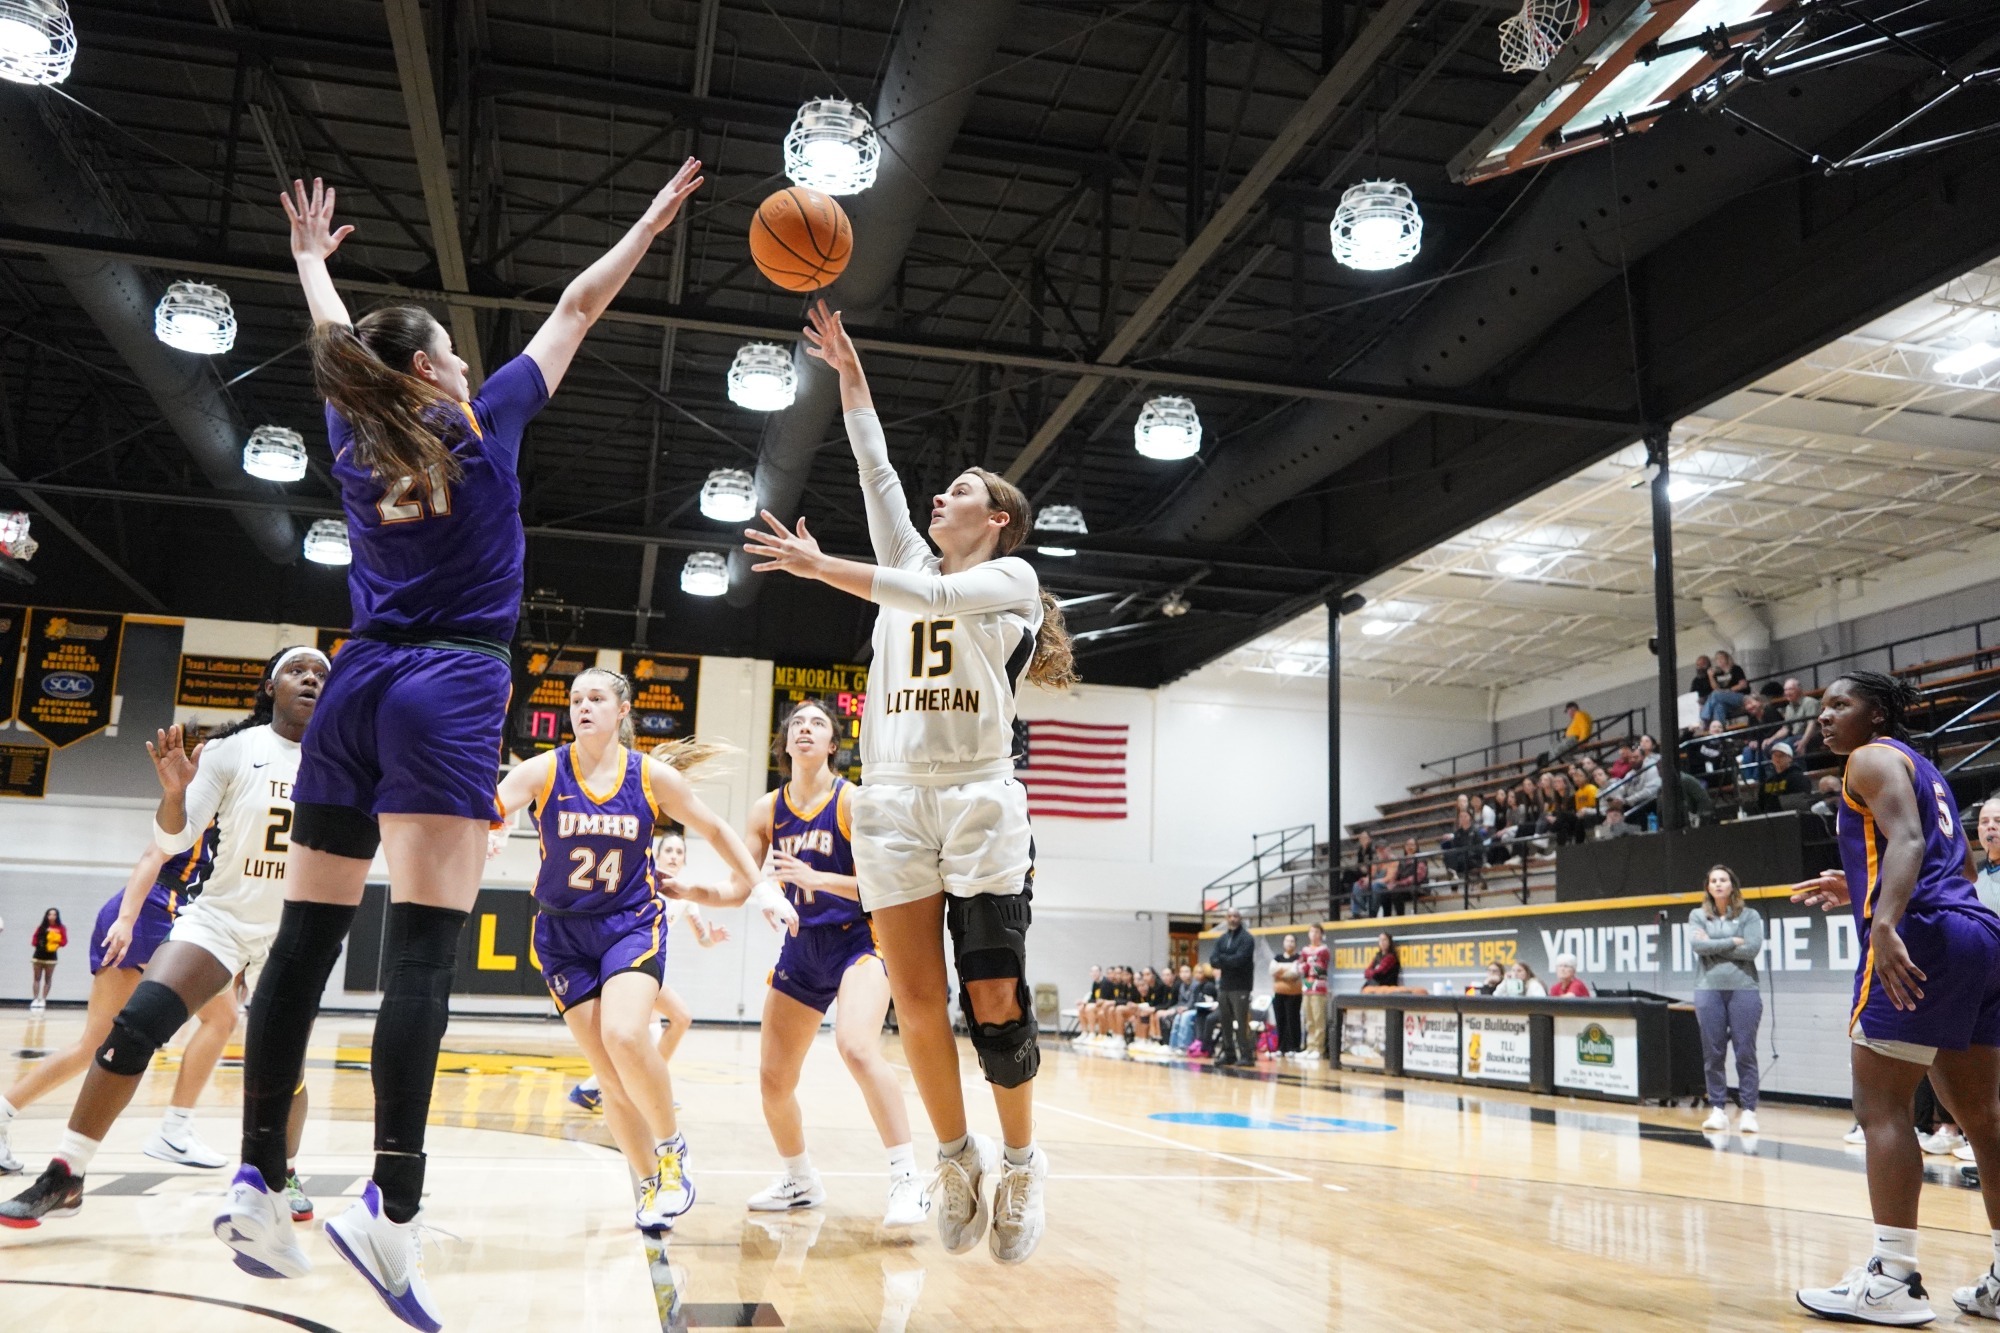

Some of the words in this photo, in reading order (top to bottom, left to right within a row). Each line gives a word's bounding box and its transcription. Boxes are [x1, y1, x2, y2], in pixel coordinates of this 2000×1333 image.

[376, 462, 452, 525] 21
[48, 652, 96, 664] Women's
[910, 619, 955, 679] 15
[41, 659, 100, 672] Basketball
[186, 658, 206, 670] Texas
[208, 659, 240, 672] Lutheran
[774, 666, 849, 690] MEMORIAL
[49, 678, 88, 692] SCAC
[38, 698, 91, 708] Conference
[634, 699, 684, 712] Basketball
[886, 688, 980, 716] LUTHERAN
[531, 711, 558, 739] 17
[642, 716, 674, 730] SCAC
[270, 780, 294, 799] TE
[1931, 780, 1954, 840] 5
[264, 807, 292, 853] 2
[558, 811, 640, 841] UMHB
[568, 846, 622, 892] 24
[1432, 942, 1475, 968] SINCE
[1478, 940, 1517, 966] 1952
[1540, 924, 1660, 973] YOU'RE
[1759, 916, 1812, 971] HE
